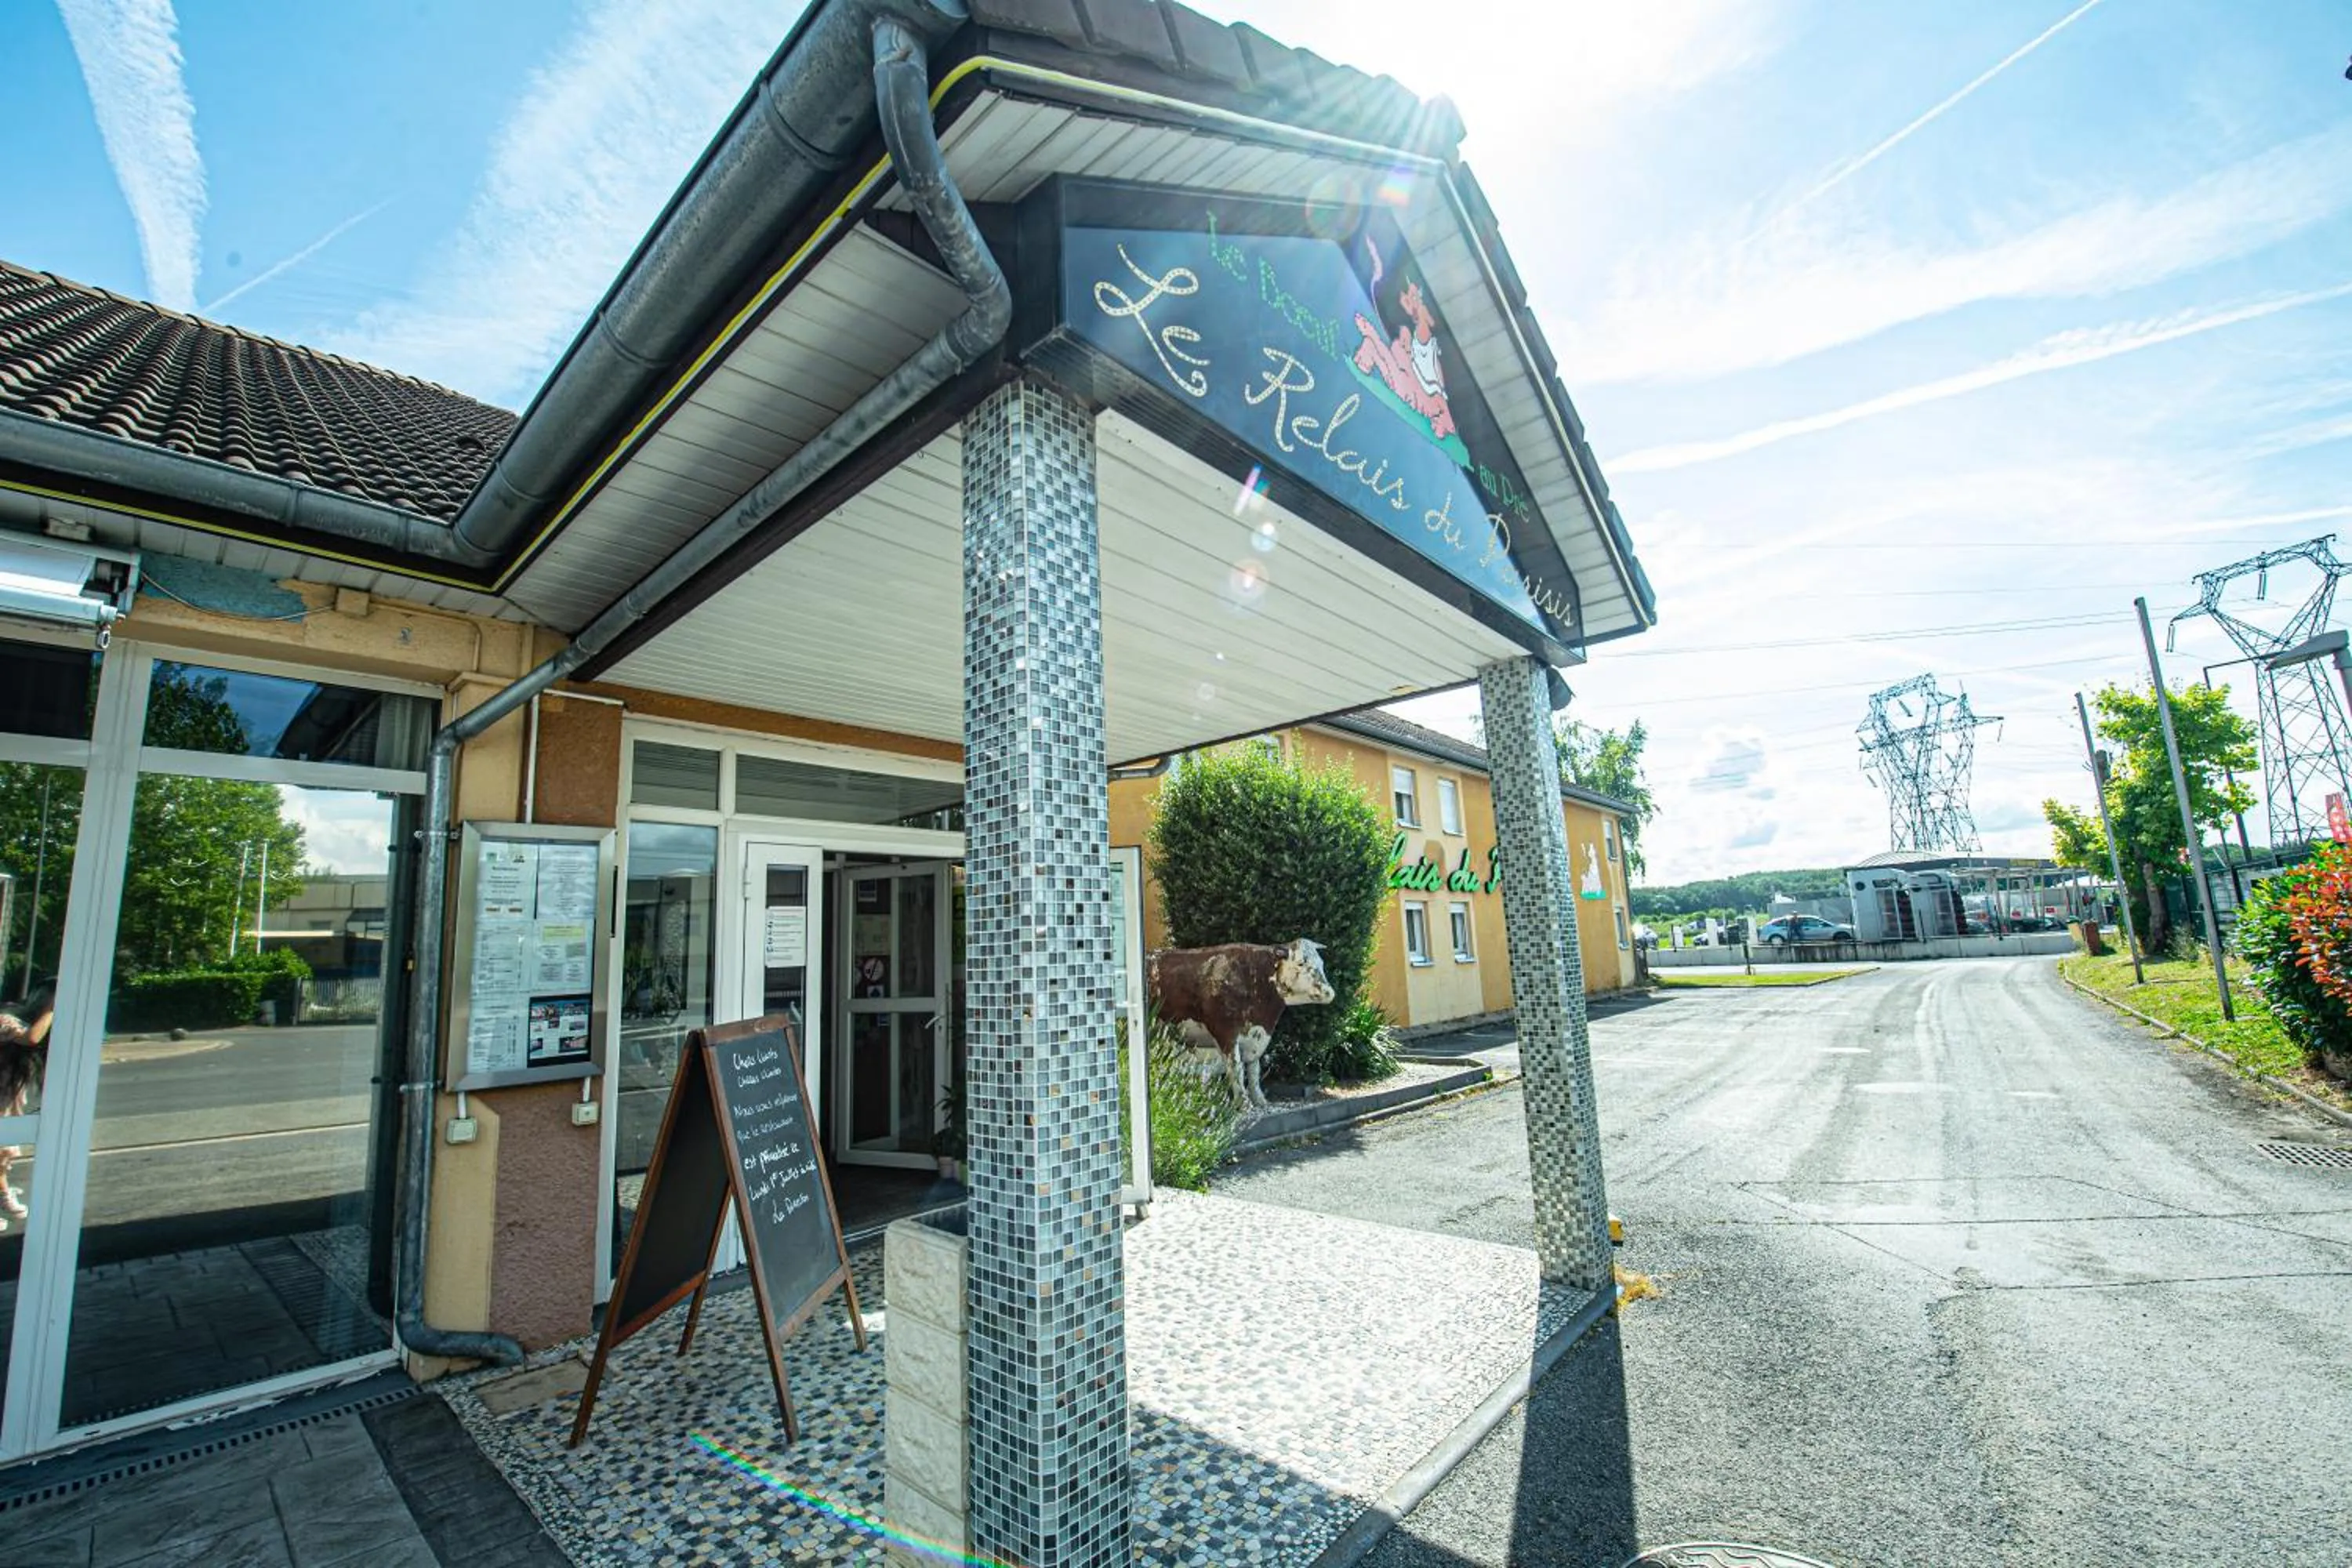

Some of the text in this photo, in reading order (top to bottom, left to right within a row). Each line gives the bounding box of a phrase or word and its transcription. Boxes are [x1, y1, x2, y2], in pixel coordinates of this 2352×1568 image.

[1094, 243, 1575, 627] Le Relais du Parisis
[1386, 830, 1444, 892] lais
[1447, 848, 1482, 892] du
[744, 1155, 757, 1170] est
